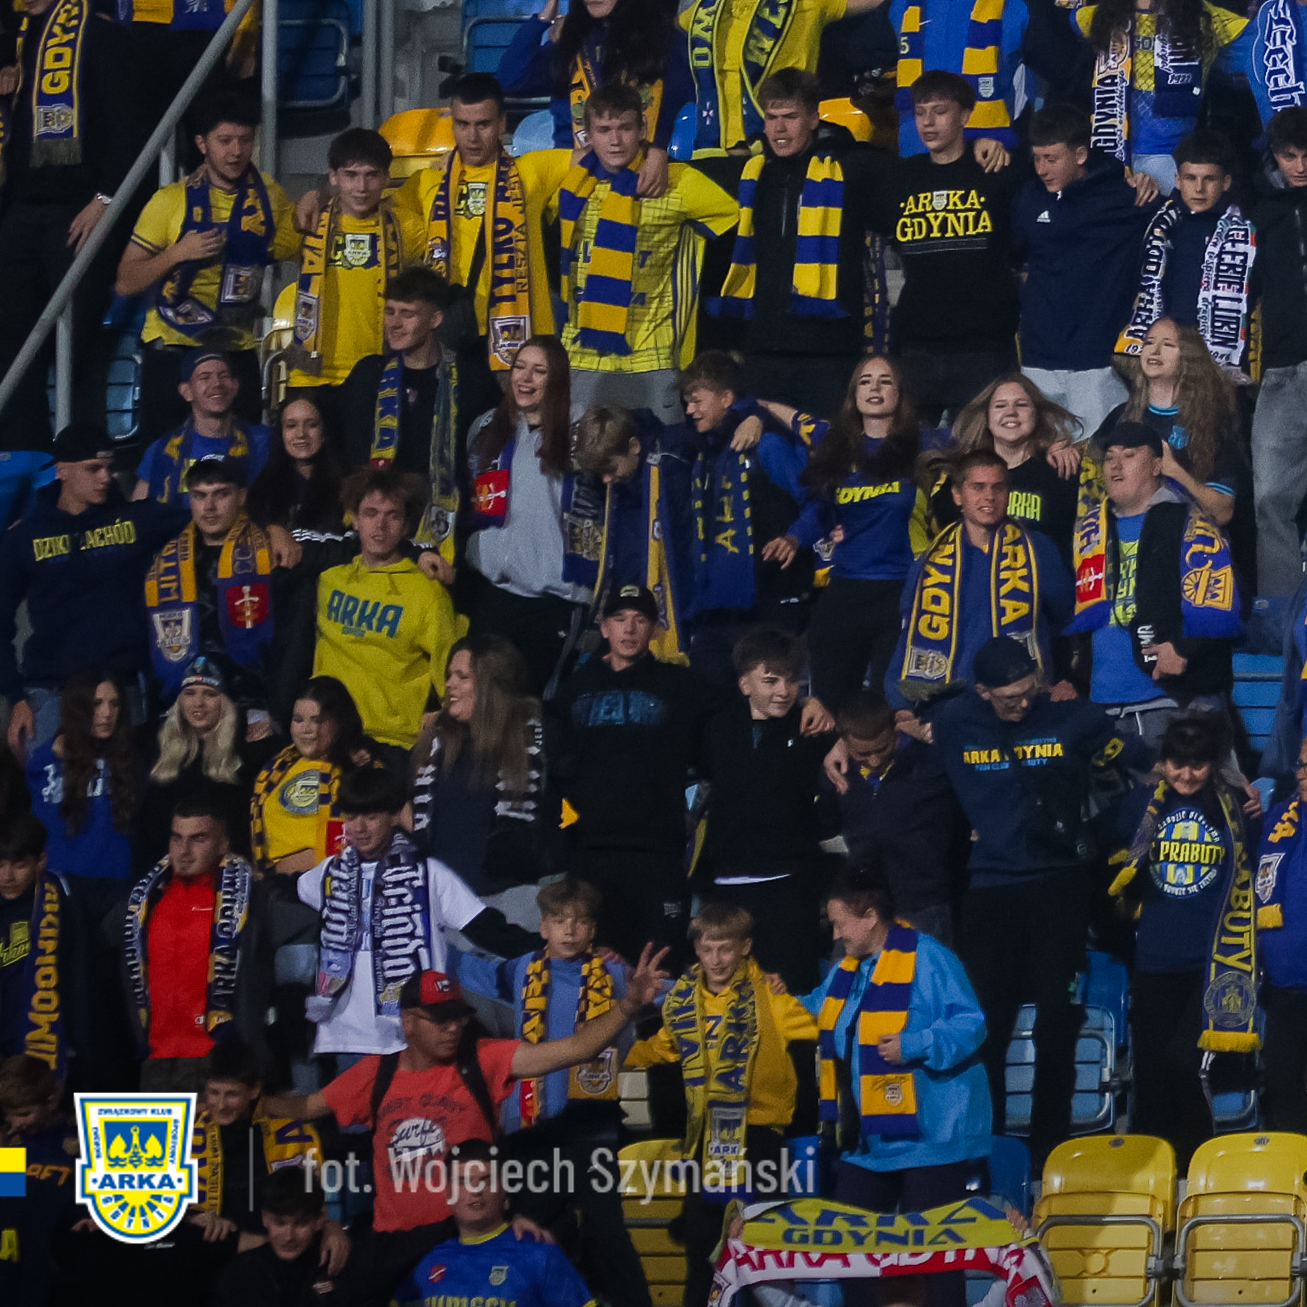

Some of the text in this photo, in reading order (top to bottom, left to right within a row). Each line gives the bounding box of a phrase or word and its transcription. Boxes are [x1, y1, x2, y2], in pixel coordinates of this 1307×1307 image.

[40, 3, 80, 95] GDYN
[897, 210, 992, 241] GDYNIA
[81, 520, 136, 552] ACHÓD
[920, 539, 956, 640] GDYN
[1001, 520, 1031, 623] ARKA
[327, 590, 403, 637] ARKA
[964, 747, 1001, 763] ARKA
[783, 1227, 966, 1247] GDYNIA
